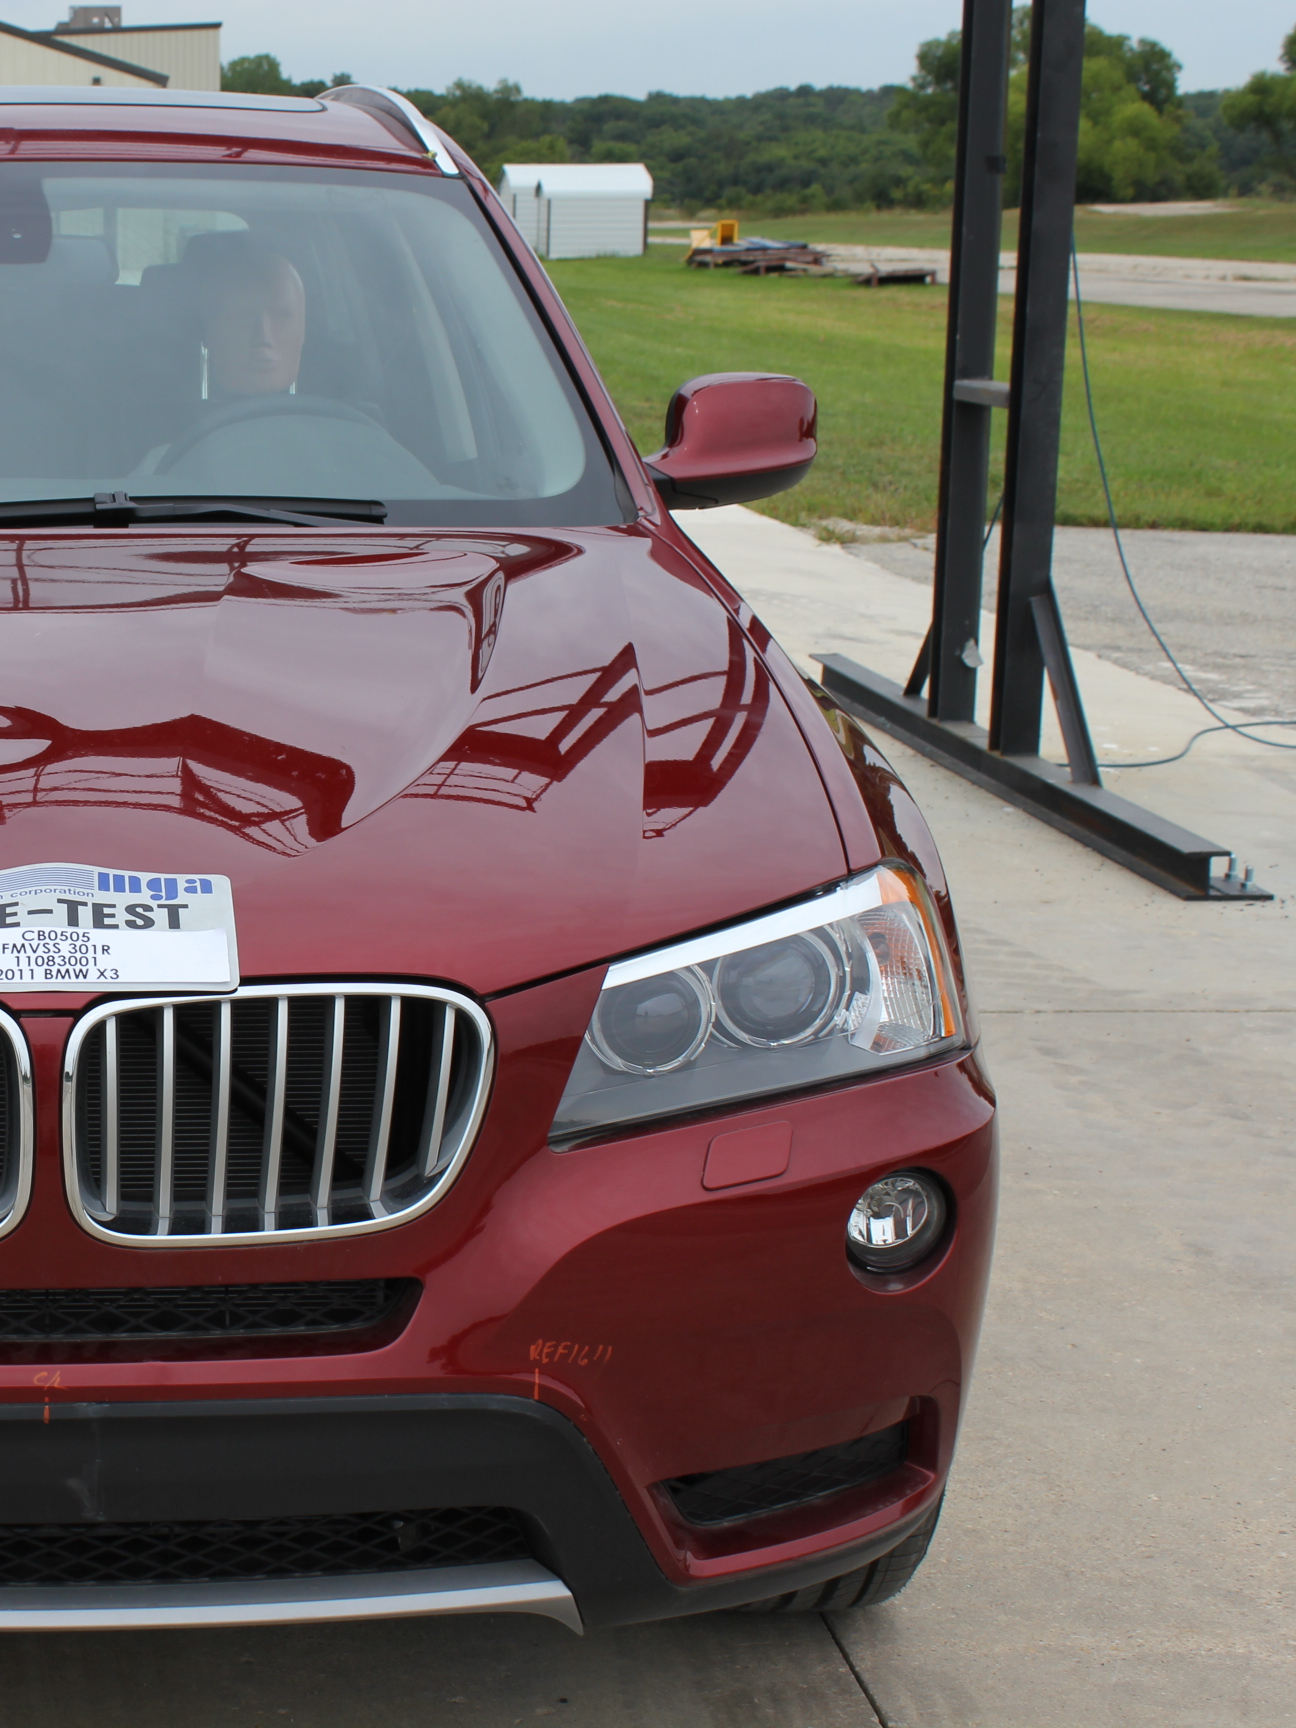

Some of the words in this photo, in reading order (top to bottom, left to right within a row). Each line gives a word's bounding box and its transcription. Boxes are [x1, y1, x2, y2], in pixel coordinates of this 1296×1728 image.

[98, 872, 213, 900] mga
[10, 887, 95, 899] corporation
[22, 930, 91, 942] CB0505
[2, 943, 61, 954] FMVSS
[68, 943, 111, 955] 301R
[14, 955, 97, 967] 11083001
[44, 968, 89, 979] BMW
[96, 969, 119, 980] X3
